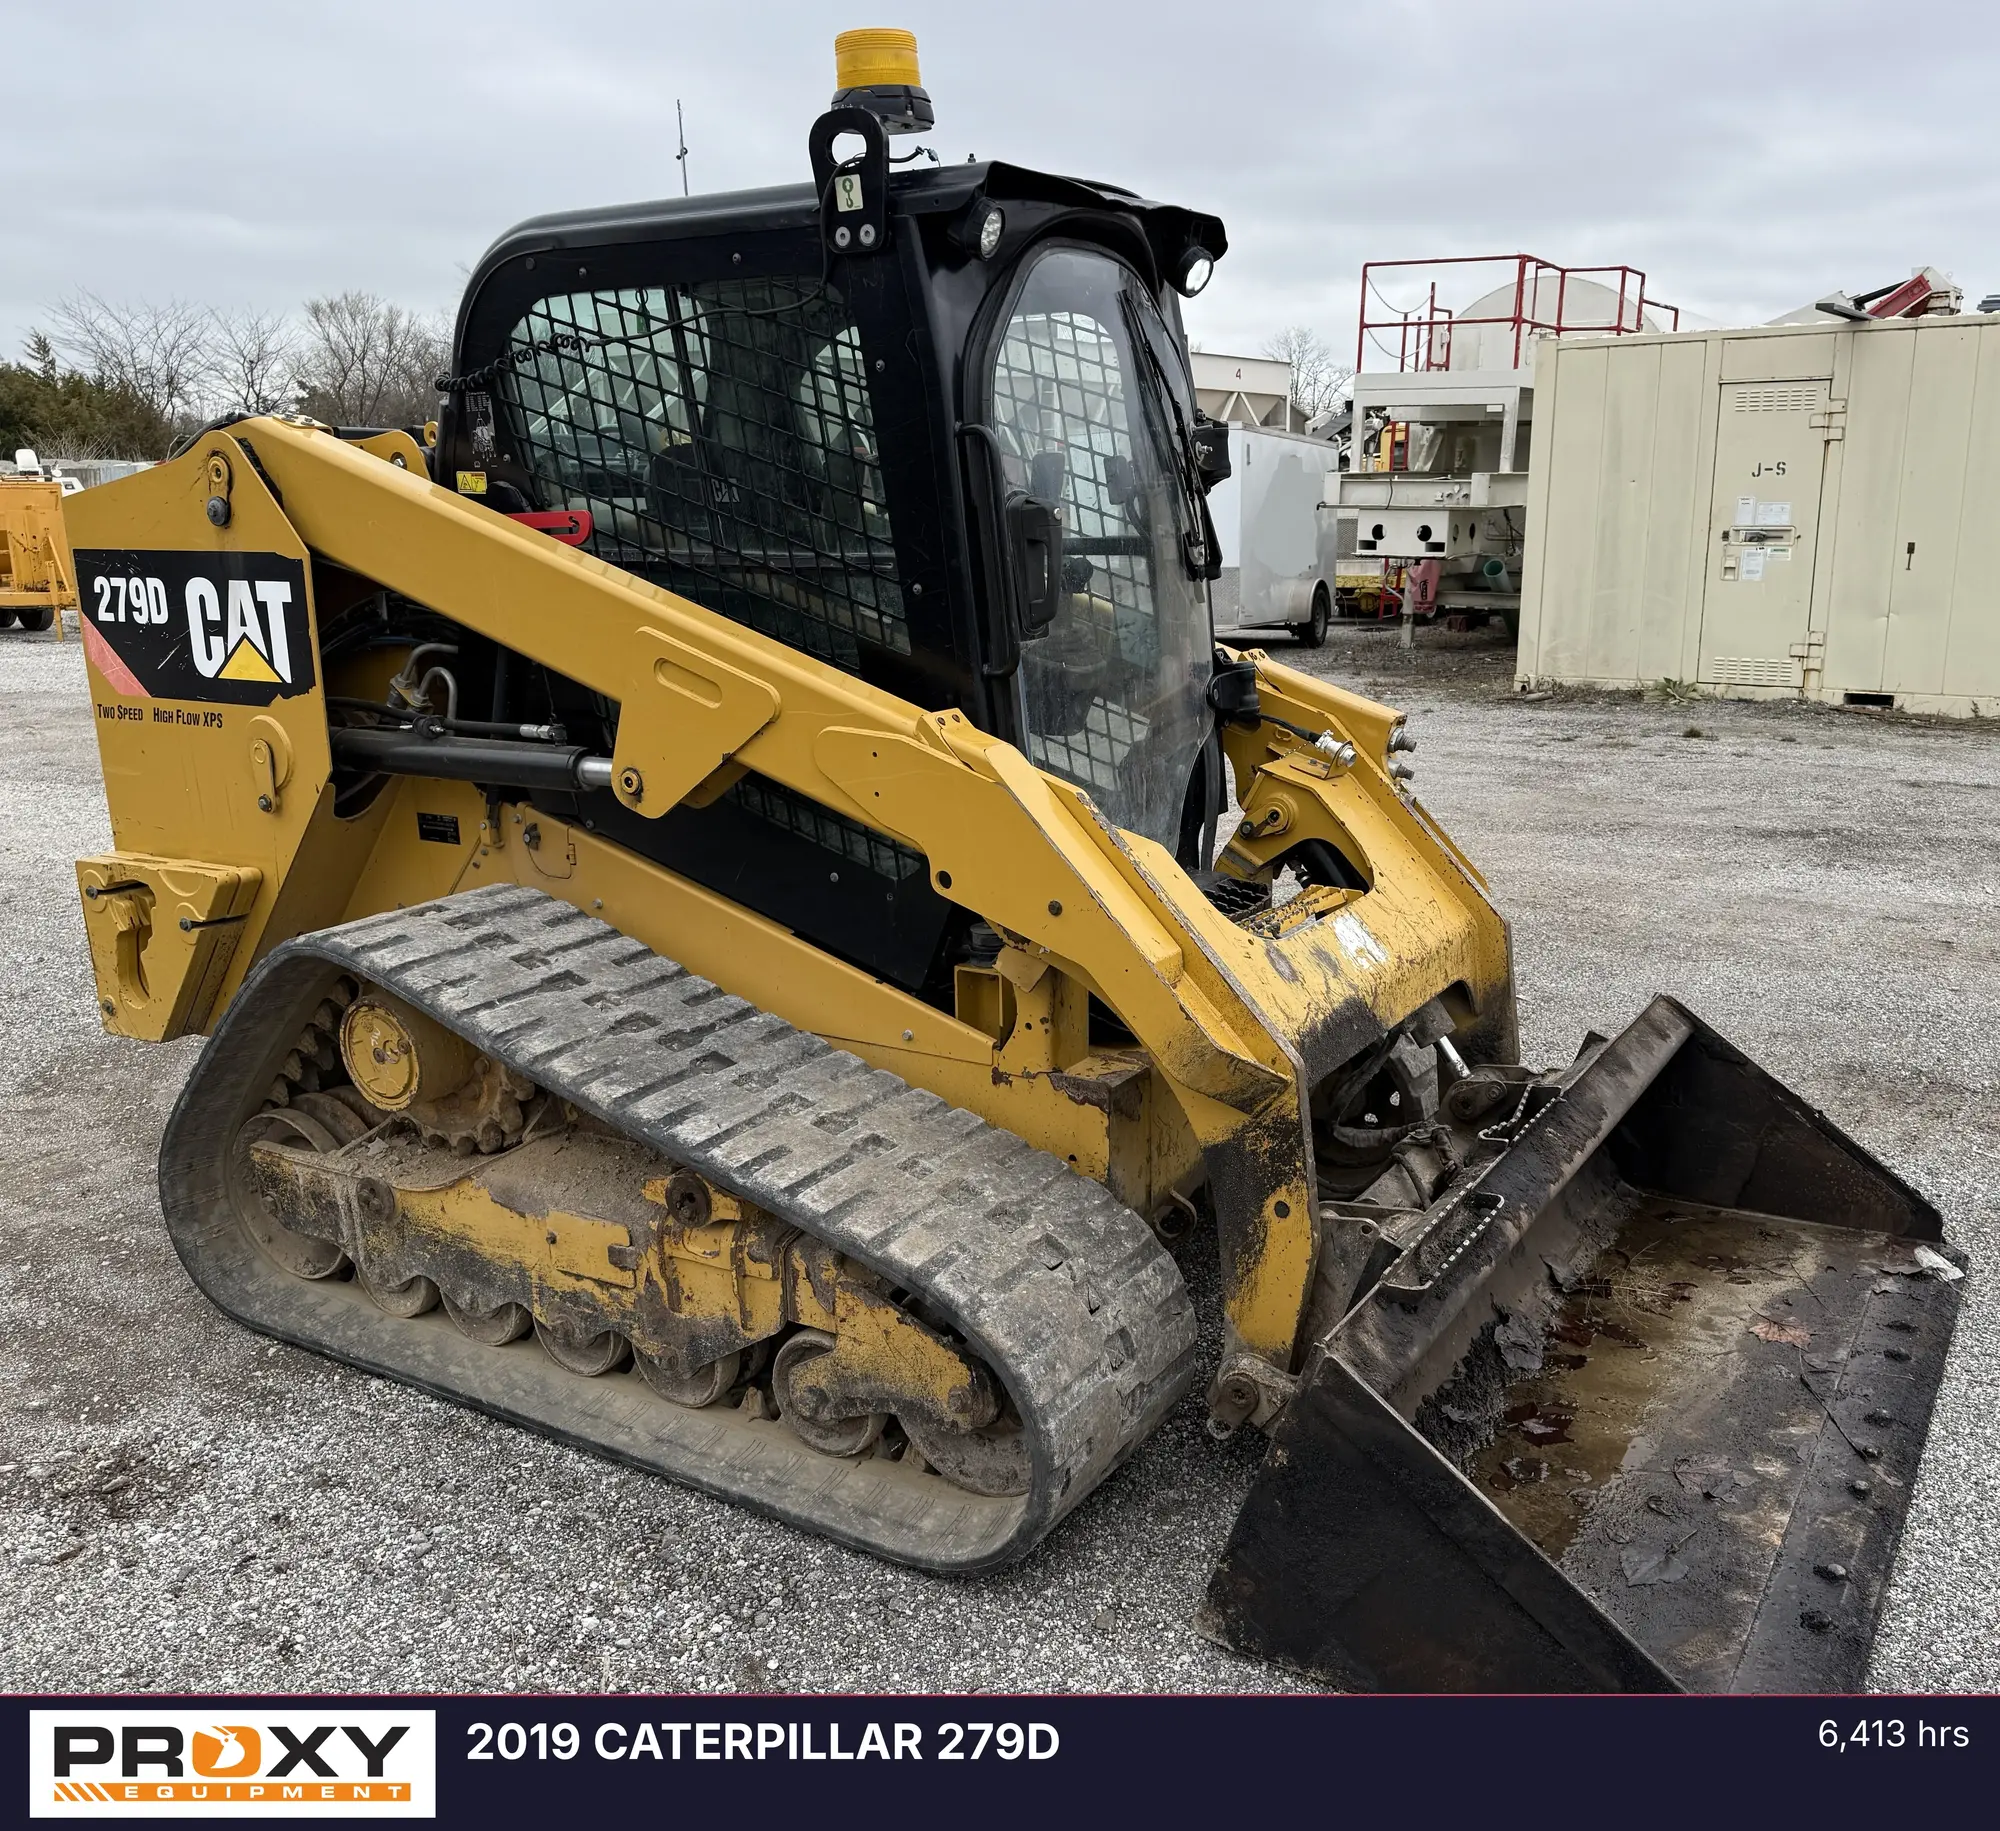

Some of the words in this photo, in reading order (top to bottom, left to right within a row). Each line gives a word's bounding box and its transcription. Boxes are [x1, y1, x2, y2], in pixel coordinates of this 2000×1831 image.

[1235, 368, 1242, 380] 4
[93, 575, 169, 625] 279D
[184, 576, 293, 684] CAT
[202, 711, 223, 729] XPS
